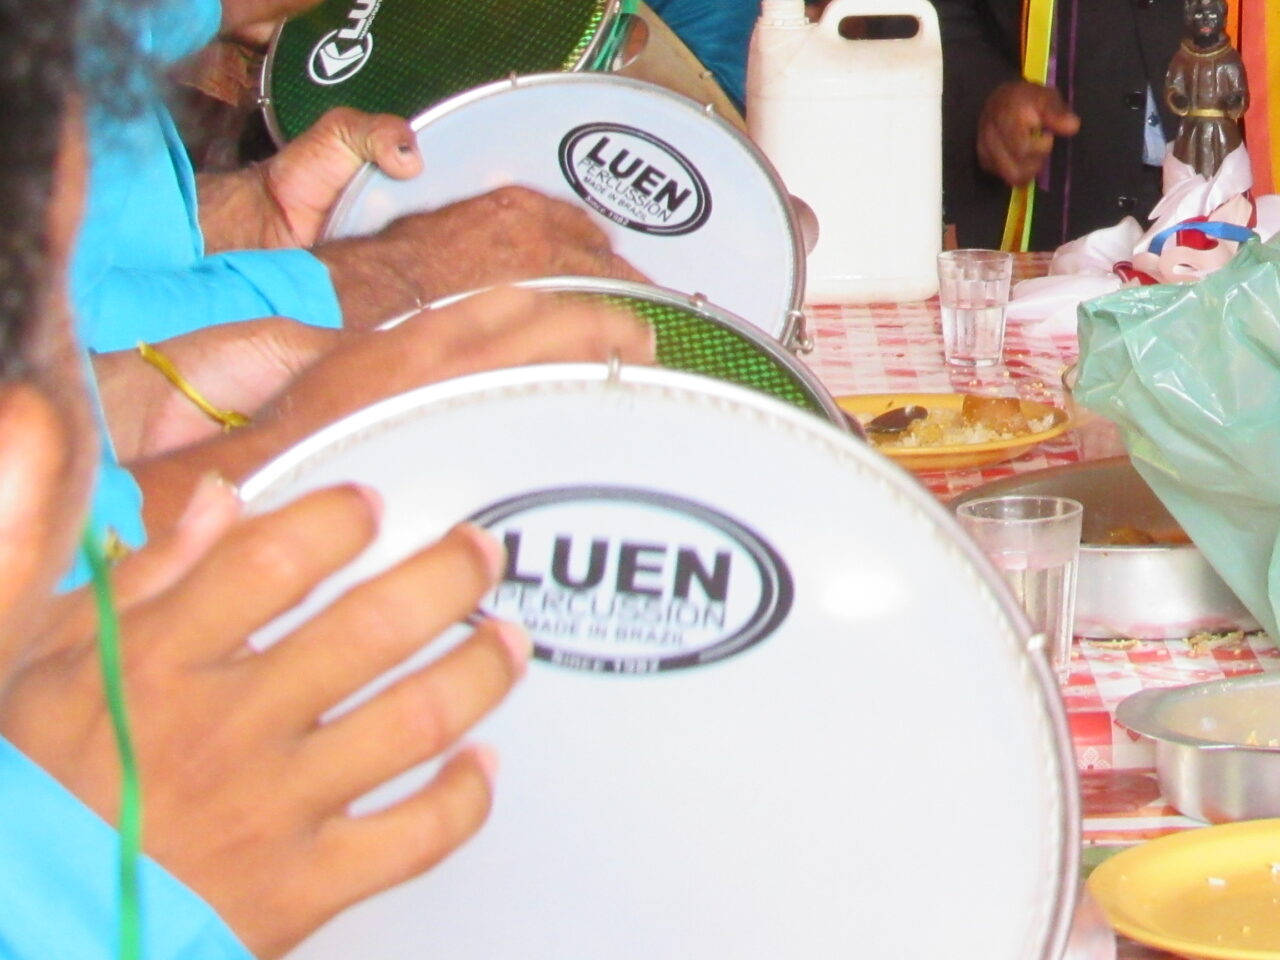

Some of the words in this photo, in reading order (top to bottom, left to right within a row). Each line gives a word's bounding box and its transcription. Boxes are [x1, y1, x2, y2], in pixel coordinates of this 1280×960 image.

[577, 158, 672, 223] PERCUSSION
[584, 176, 607, 197] MADE
[608, 193, 617, 203] IN
[618, 199, 648, 222] BRAZIL
[587, 136, 692, 213] LUEN
[502, 529, 732, 602] LUEN
[492, 585, 728, 630] PERCUSSION
[524, 615, 578, 637] MADE
[588, 622, 607, 640] IN
[614, 624, 684, 646] BRAZIL
